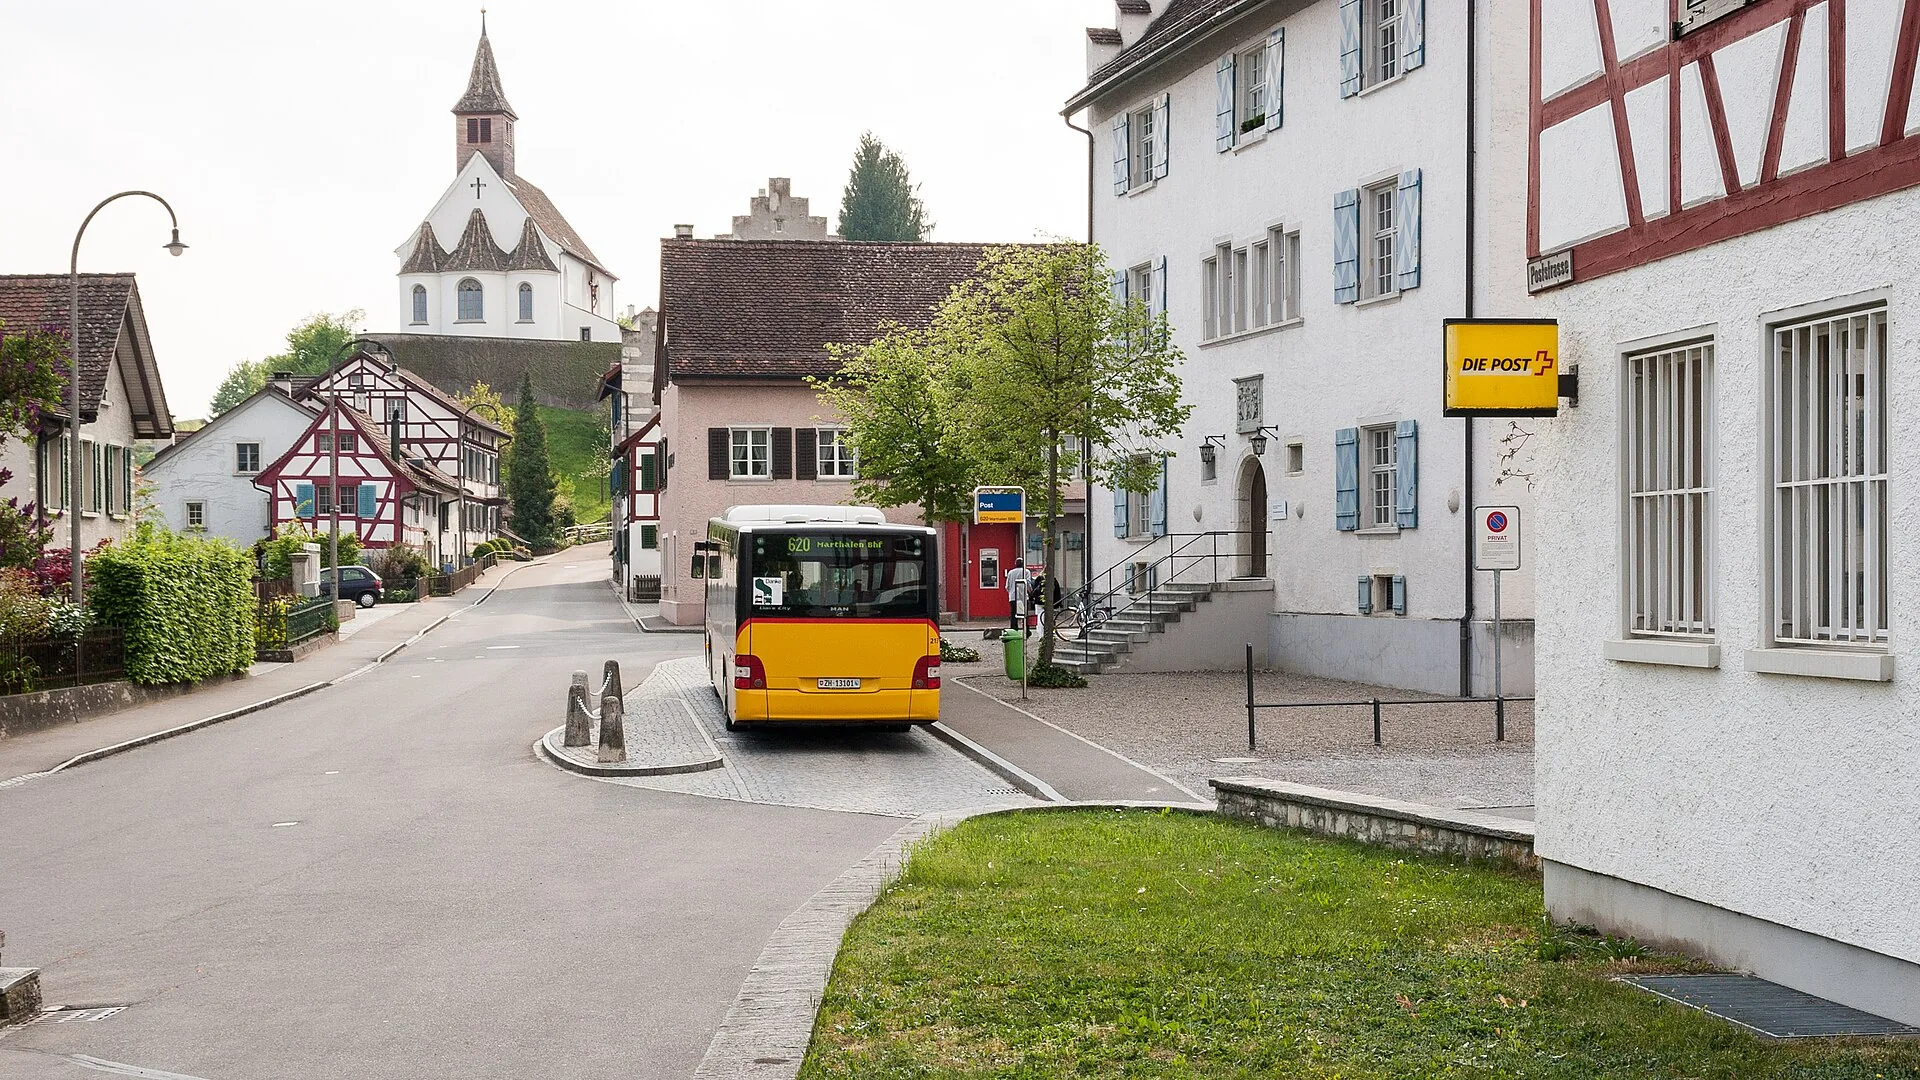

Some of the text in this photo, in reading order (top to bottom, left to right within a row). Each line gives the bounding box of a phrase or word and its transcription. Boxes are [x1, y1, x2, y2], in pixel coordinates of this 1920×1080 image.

[1530, 259, 1569, 285] Poststrasse
[1462, 358, 1532, 371] DIE POST
[788, 537, 883, 552] 620 Marthalen Bhf
